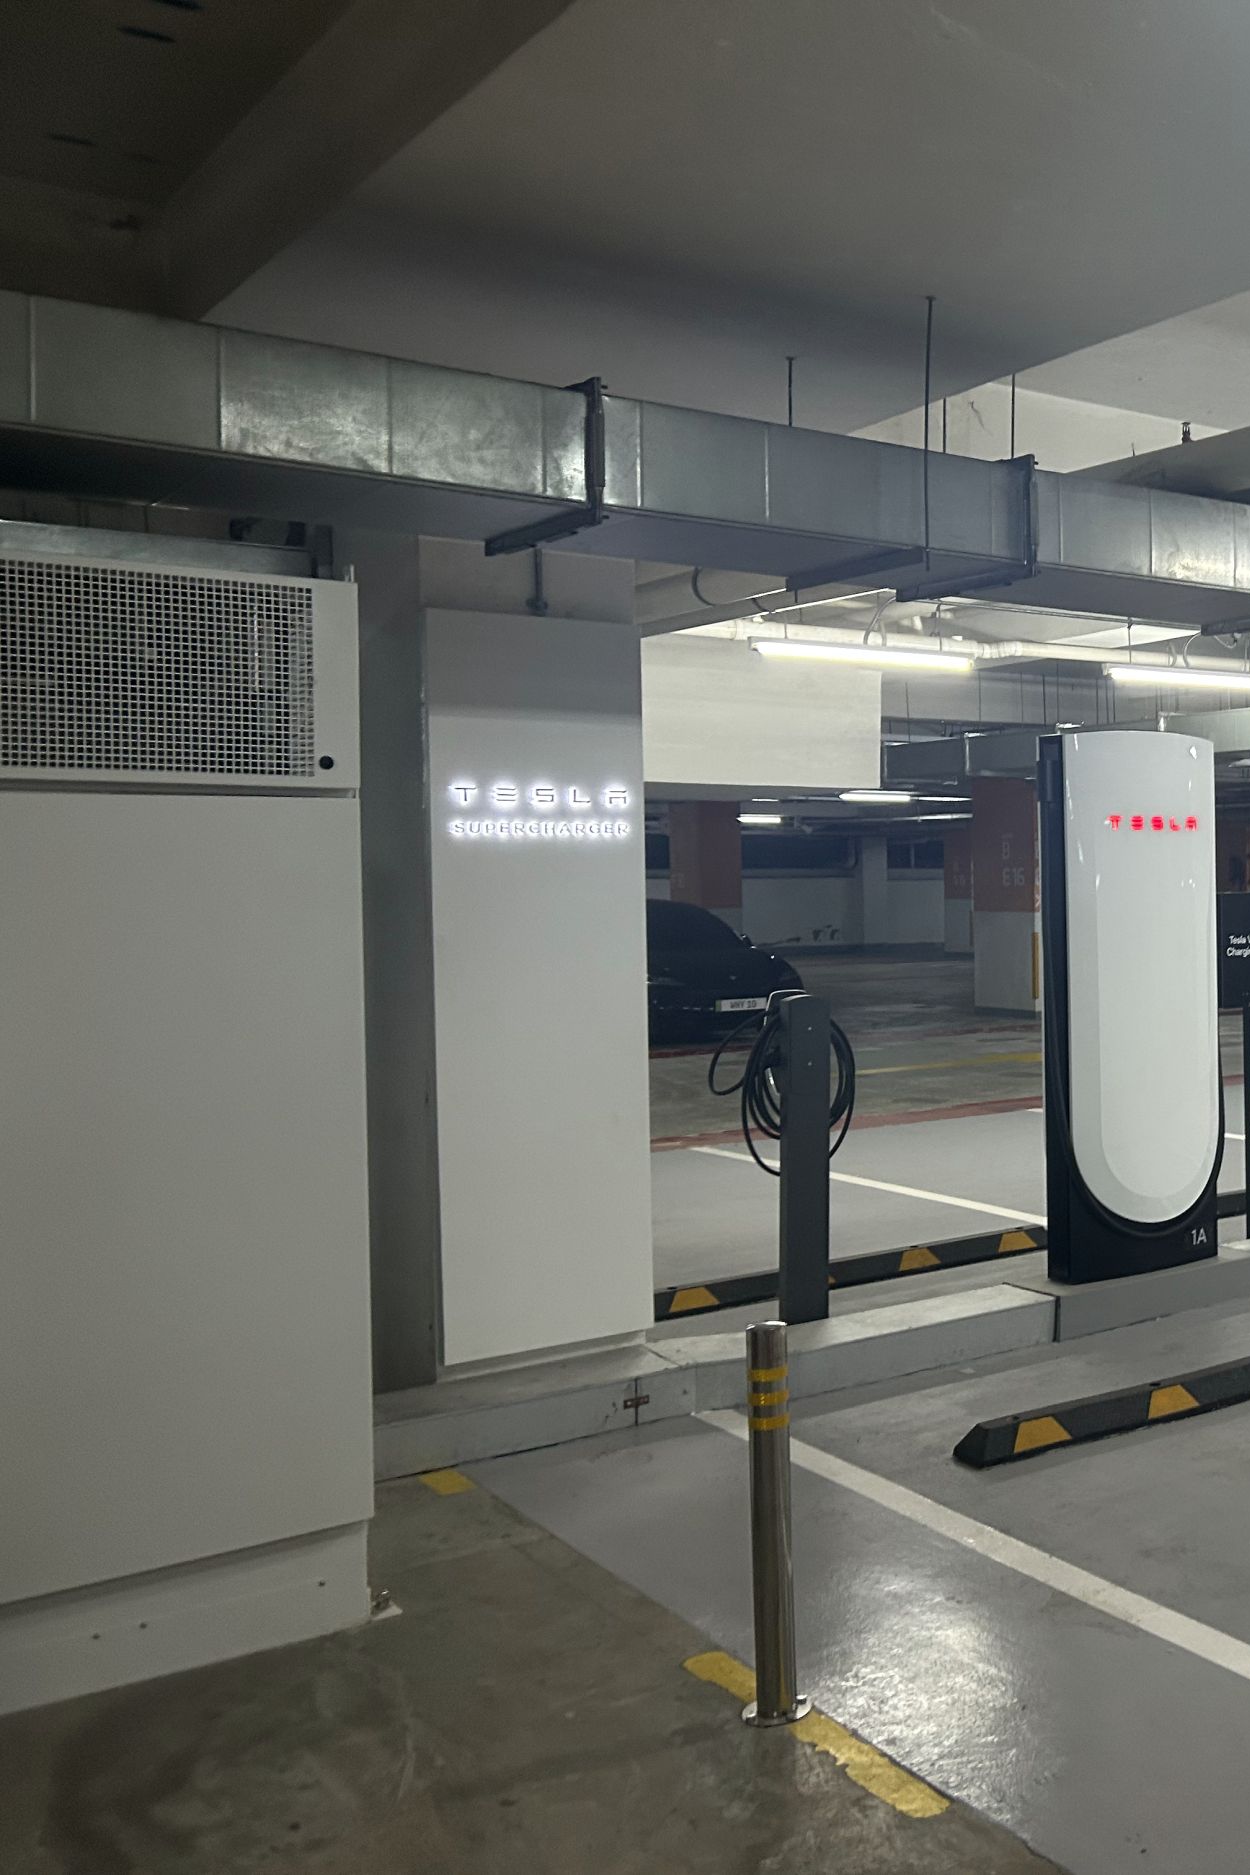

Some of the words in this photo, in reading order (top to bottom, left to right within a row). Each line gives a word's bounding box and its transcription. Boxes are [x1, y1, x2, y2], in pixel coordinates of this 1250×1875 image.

[453, 786, 628, 805] TESLA
[453, 821, 630, 836] SUPERCHARGER
[1106, 814, 1198, 832] TESLA
[1229, 934, 1247, 944] Tesla
[1191, 1226, 1207, 1245] 1A
